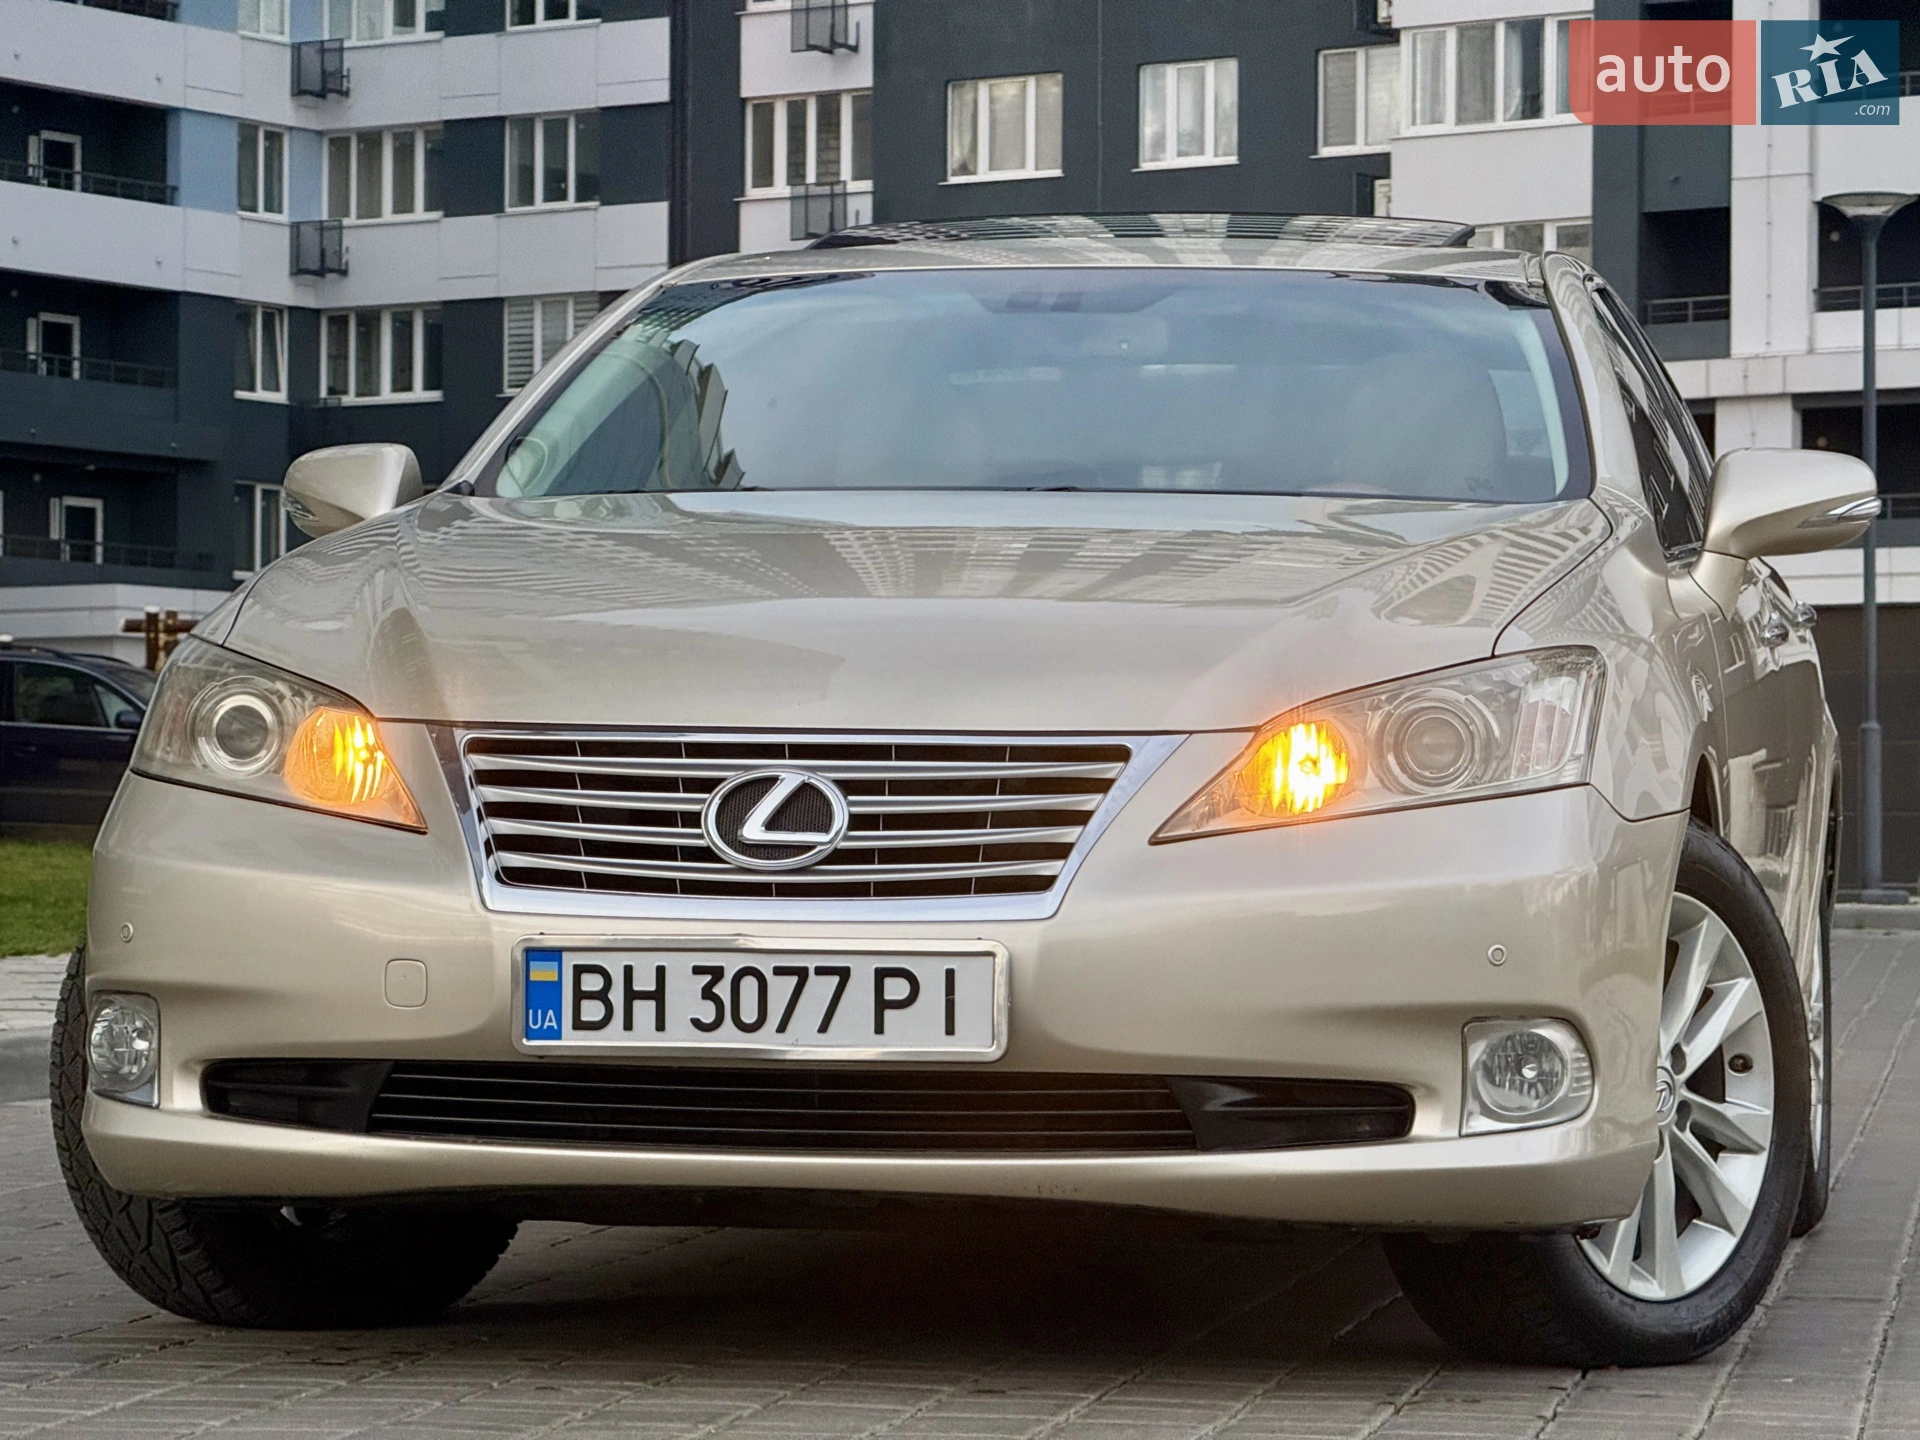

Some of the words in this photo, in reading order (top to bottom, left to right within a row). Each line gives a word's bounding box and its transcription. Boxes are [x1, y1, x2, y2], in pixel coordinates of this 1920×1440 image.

[528, 1008, 558, 1030] UA
[571, 963, 666, 1032] BH
[689, 965, 851, 1034] 3077
